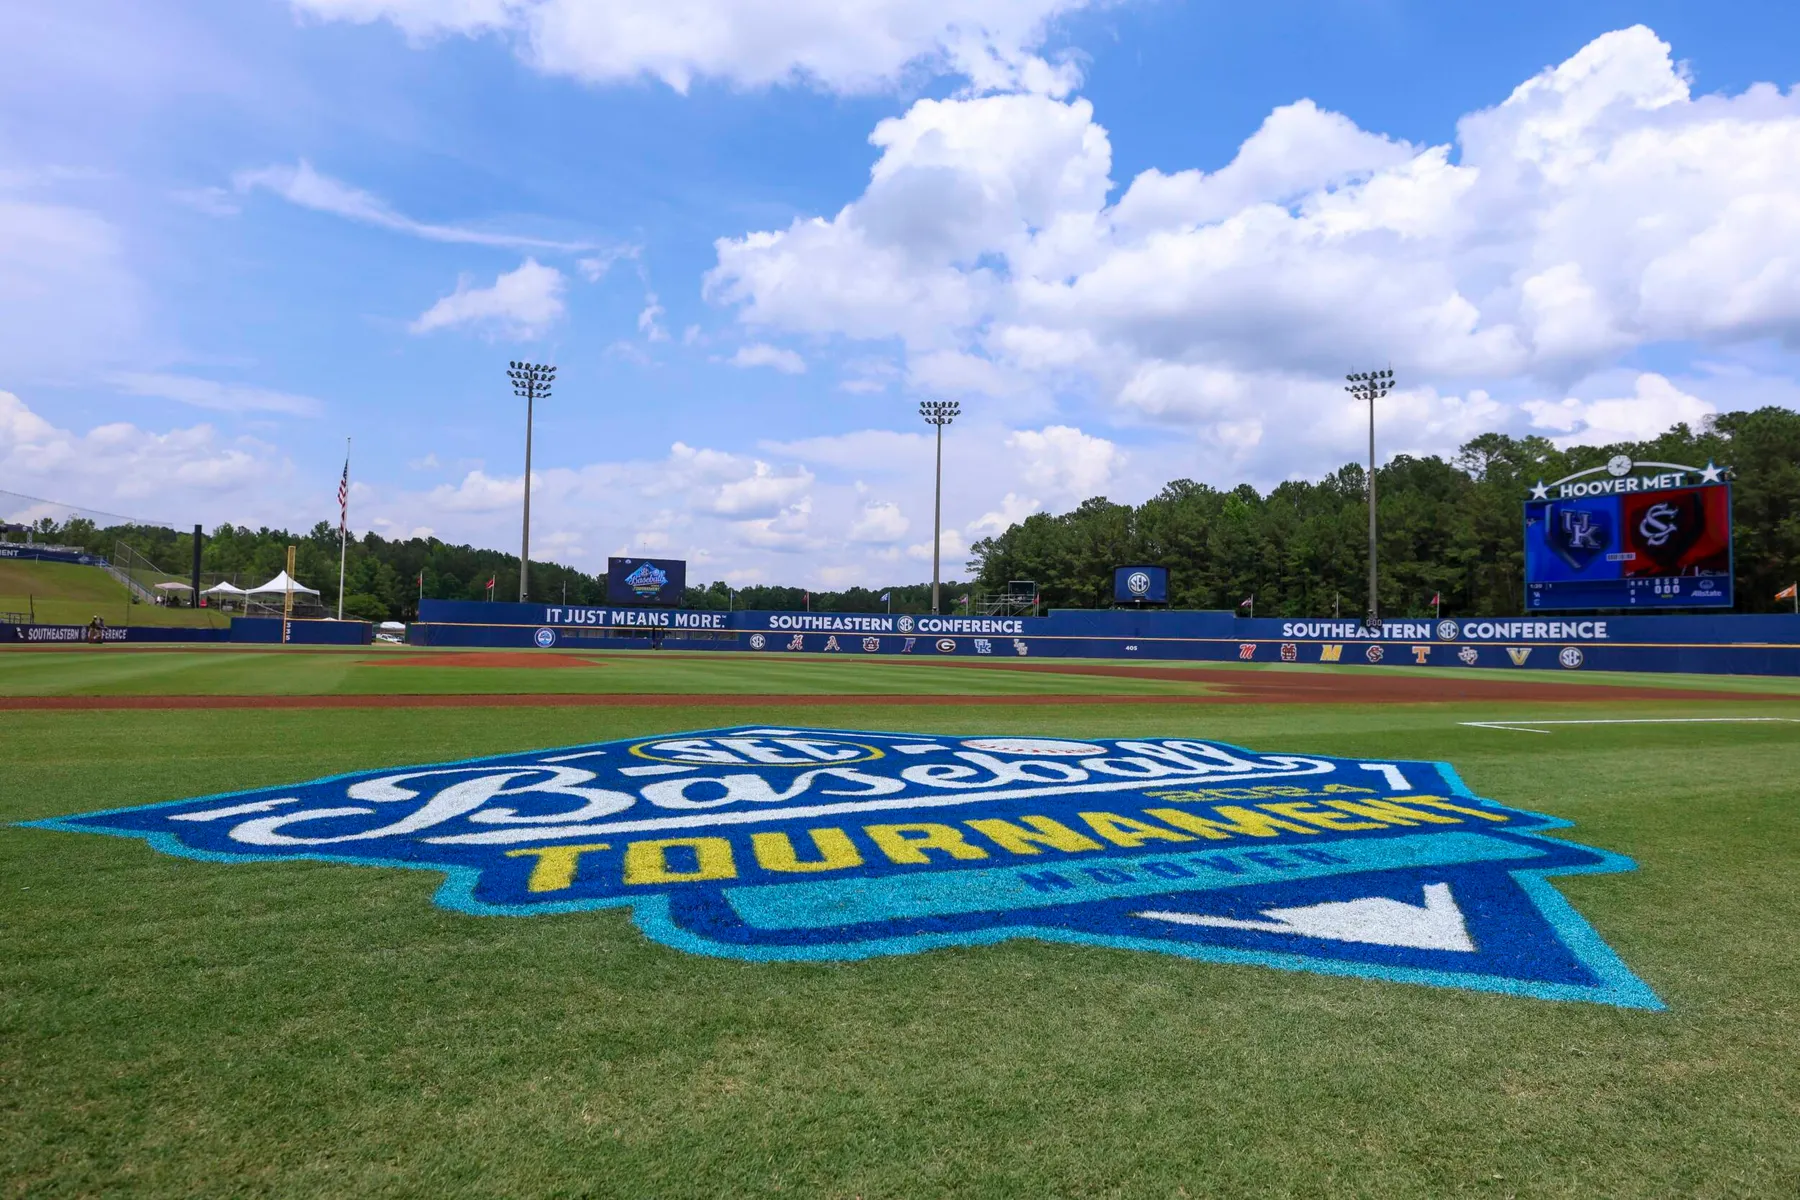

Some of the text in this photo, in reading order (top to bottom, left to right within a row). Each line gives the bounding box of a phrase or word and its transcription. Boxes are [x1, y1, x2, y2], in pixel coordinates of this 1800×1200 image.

[1560, 474, 1685, 498] HOOVER MET
[1129, 573, 1149, 593] SEC
[546, 608, 562, 623] IT
[564, 609, 606, 624] JUST
[611, 611, 669, 627] MEANS
[769, 615, 1023, 633] SOUTHEASTERN SEC CONFERENCE
[28, 627, 79, 640] SOUTHEASTERN
[1283, 621, 1607, 640] SOUTHEASTERN SEC CONFERENCE
[1561, 648, 1582, 668] SEC
[651, 738, 862, 763] SEC
[228, 739, 1336, 848] Baseball
[1142, 784, 1379, 802] 2024
[505, 795, 1508, 893] TOURNAMENT
[1017, 848, 1350, 894] HOOVER
